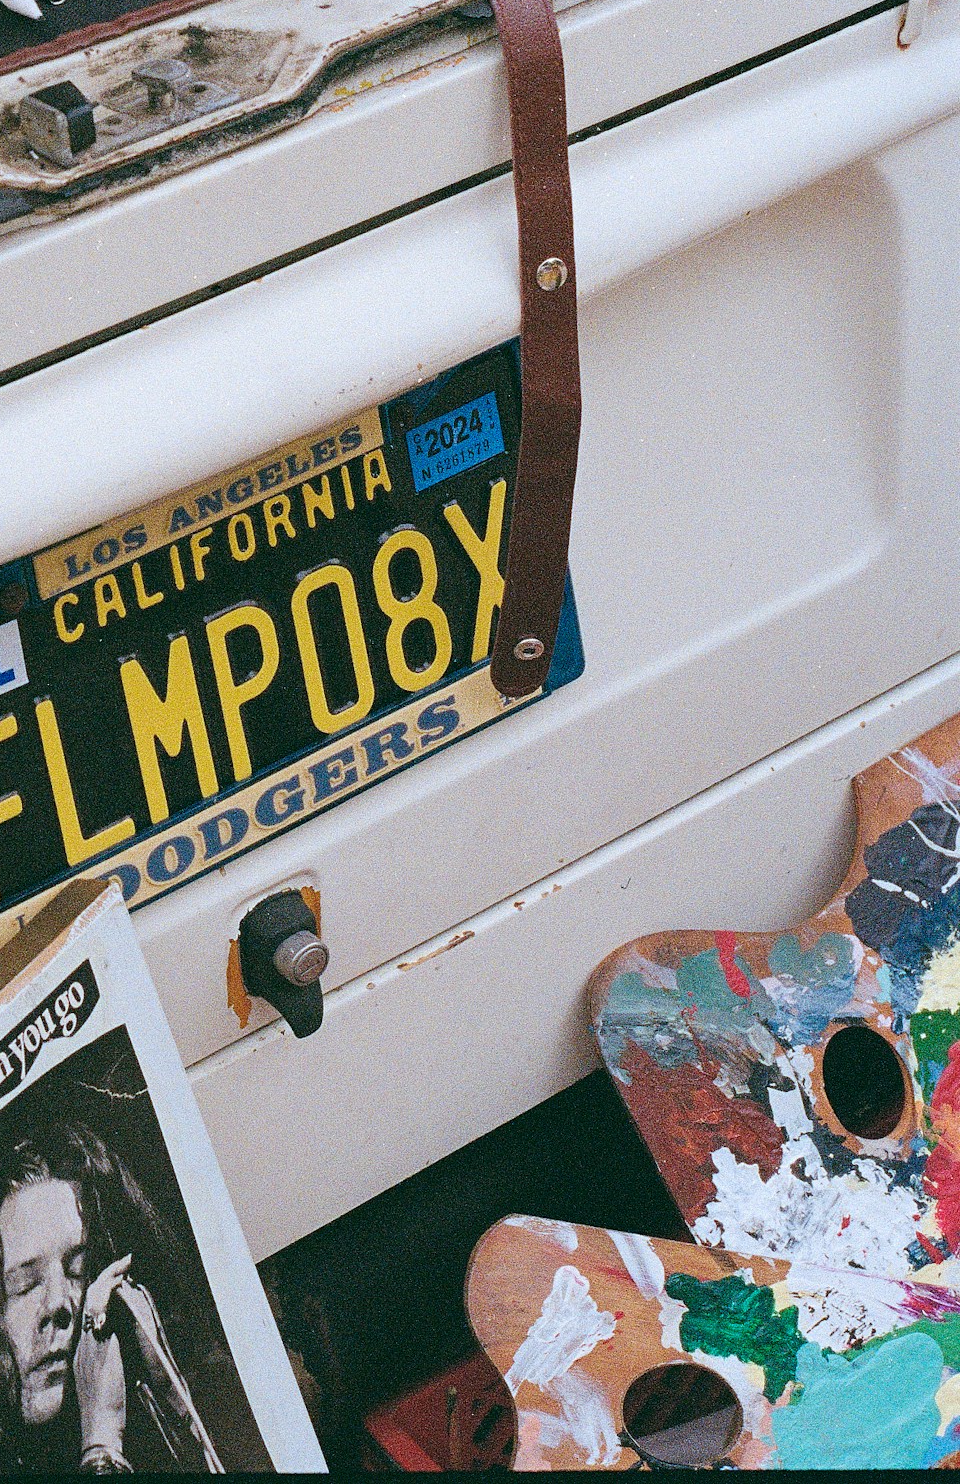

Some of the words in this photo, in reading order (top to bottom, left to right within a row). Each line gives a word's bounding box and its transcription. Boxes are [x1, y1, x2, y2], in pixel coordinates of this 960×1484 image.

[424, 407, 484, 458] 2024
[54, 448, 392, 644] CALIFORNIA
[64, 523, 148, 580] LOS
[168, 424, 363, 534] ANGELES
[7, 1006, 57, 1081] you
[55, 981, 85, 1038] go
